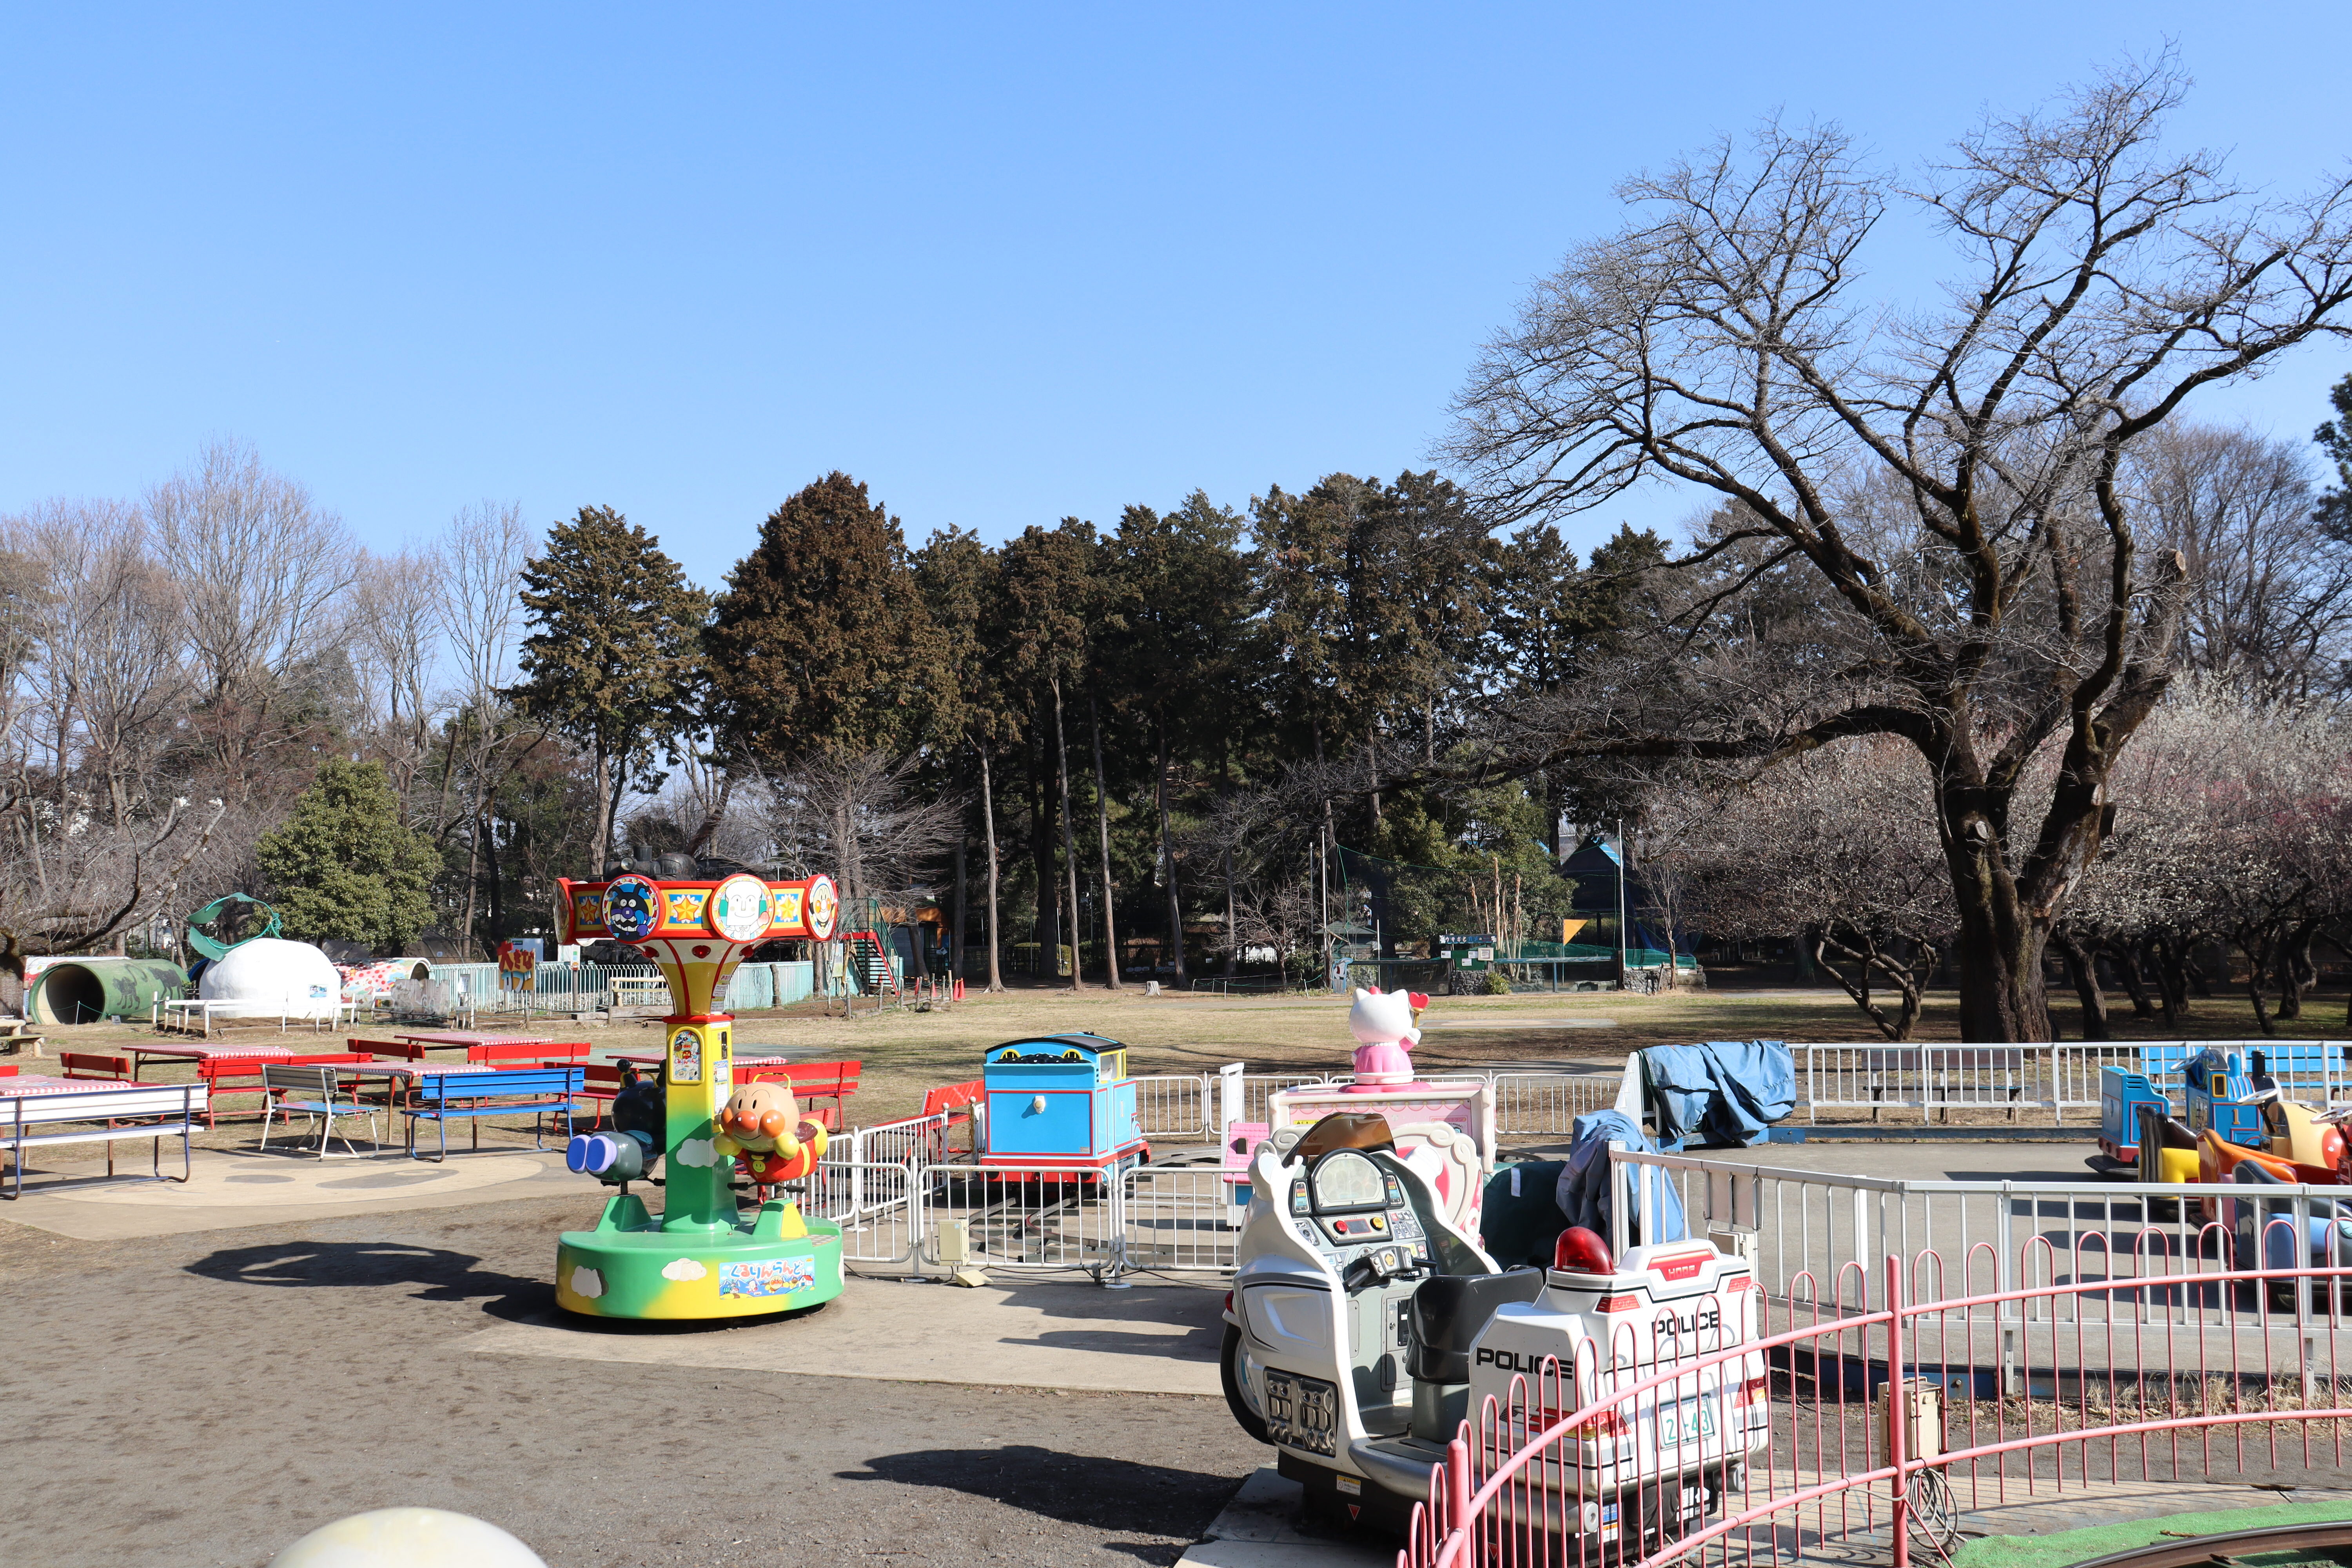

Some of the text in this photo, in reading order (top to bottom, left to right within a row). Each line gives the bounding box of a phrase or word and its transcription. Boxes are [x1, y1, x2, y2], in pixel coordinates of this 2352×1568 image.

[497, 940, 534, 973] 大きな
[501, 969, 531, 993] カブ
[2233, 1109, 2240, 1125] 1
[731, 1261, 803, 1279] くるりんらんど
[1668, 1265, 1696, 1279] HOPE
[1651, 1310, 1719, 1339] POLICE
[1477, 1347, 1573, 1379] POLICE
[1666, 1410, 1710, 1440] 2-43
